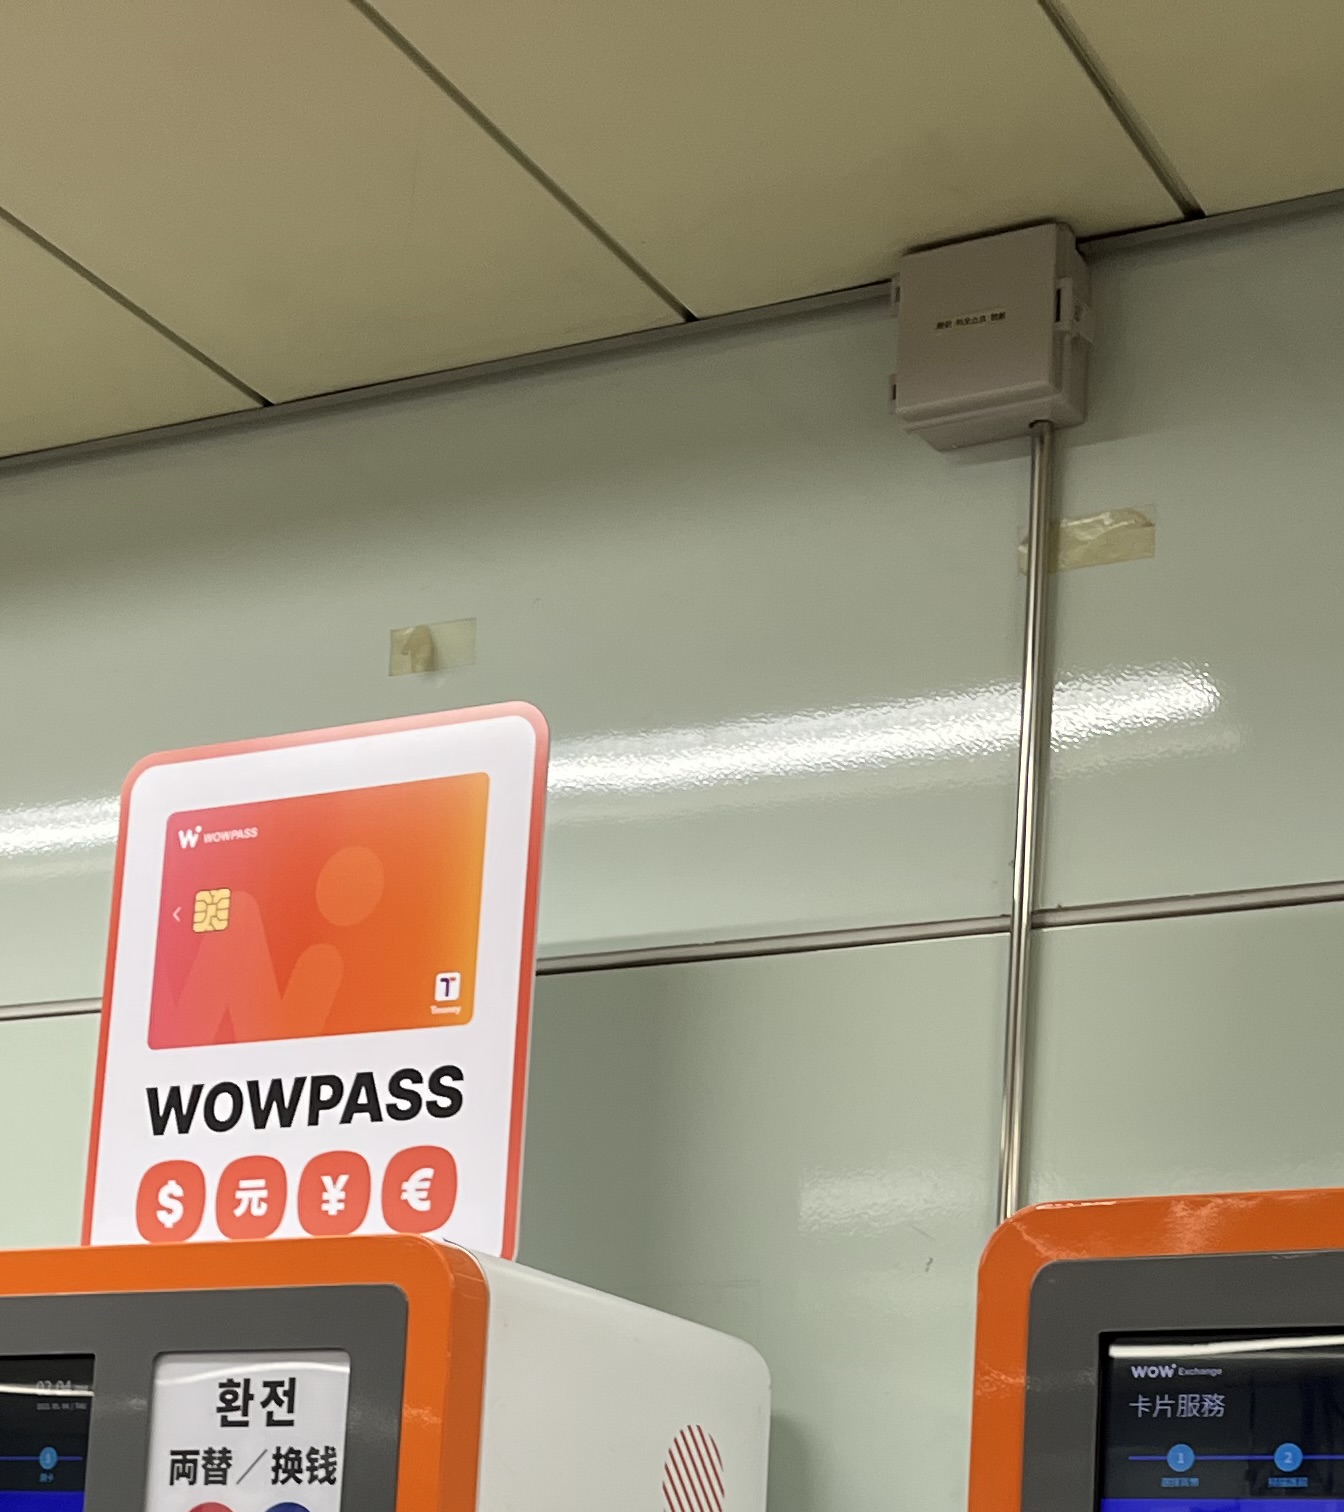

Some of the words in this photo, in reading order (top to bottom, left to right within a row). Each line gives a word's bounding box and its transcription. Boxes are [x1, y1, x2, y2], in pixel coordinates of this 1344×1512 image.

[203, 827, 258, 843] WOWPASS
[146, 1064, 464, 1136] WOWPASS
[155, 1180, 184, 1228] $
[234, 1179, 269, 1216] 元
[320, 1175, 349, 1216] ¥
[401, 1168, 434, 1211] €
[1178, 1367, 1223, 1378] Exchange
[216, 1377, 297, 1428] 환전
[1129, 1393, 1225, 1418] 卡片服務
